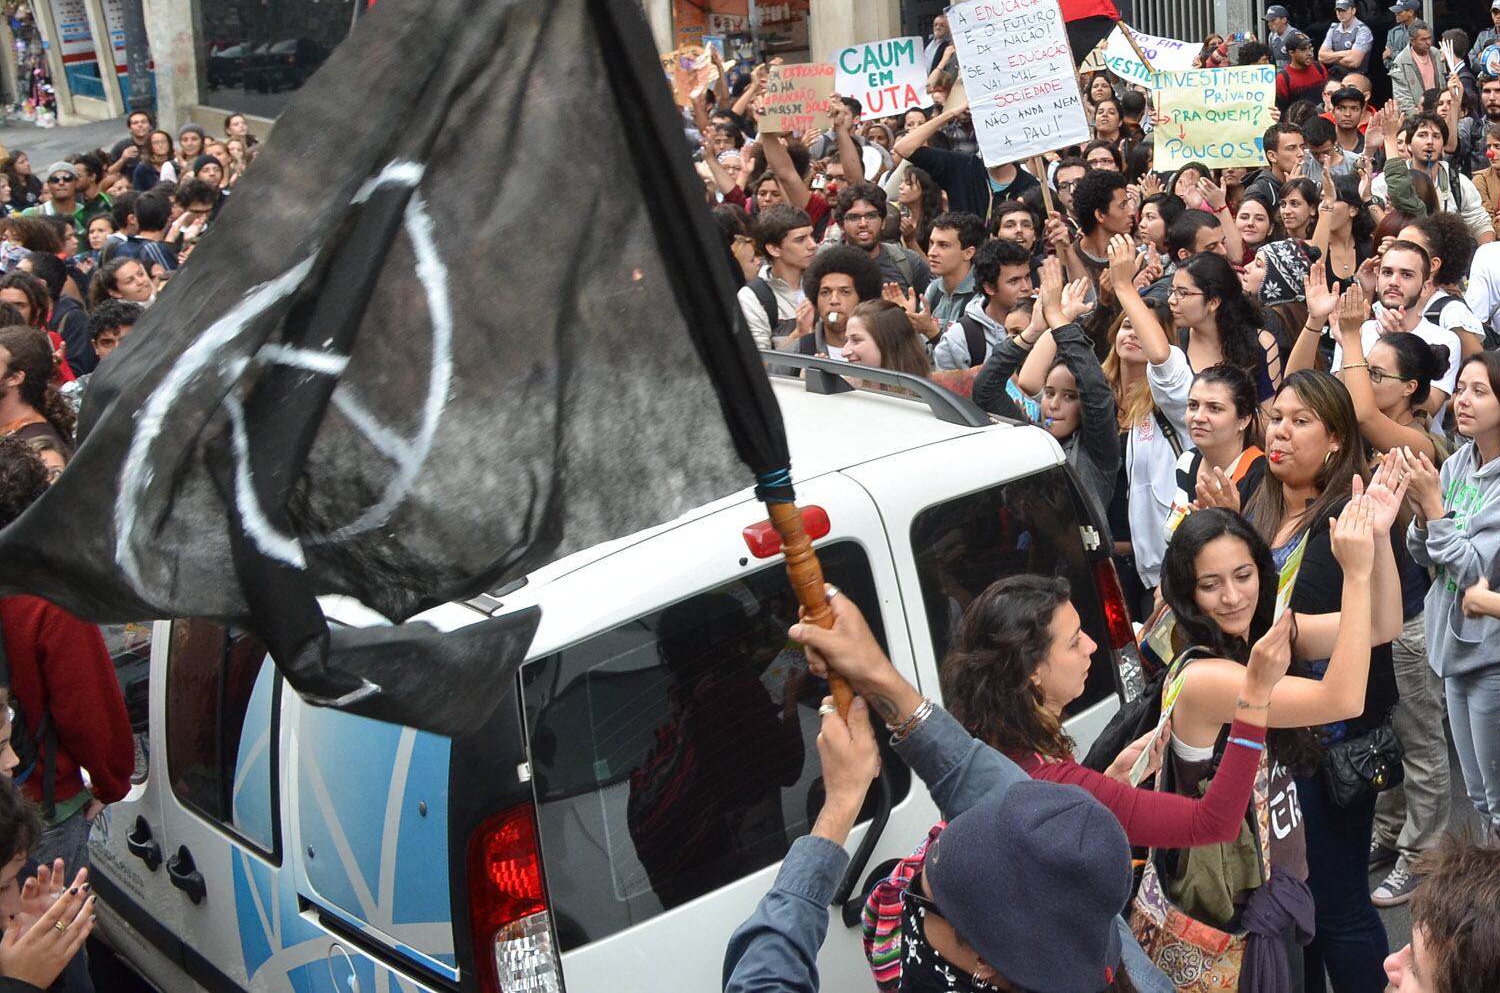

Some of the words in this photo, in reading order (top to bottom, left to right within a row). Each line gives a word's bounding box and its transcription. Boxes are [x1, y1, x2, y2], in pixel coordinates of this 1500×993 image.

[984, 23, 996, 37] O
[1003, 9, 1056, 32] FUTURO
[976, 44, 992, 55] DA
[1156, 39, 1183, 50] FIM
[839, 38, 915, 75] CAUM
[993, 62, 1001, 72] A
[1007, 41, 1068, 68] EDUCAÇÃO
[868, 70, 894, 88] EM
[983, 79, 1001, 91] VAI
[1012, 69, 1036, 85] MAL
[1152, 68, 1275, 90] INVESTIMENTO
[994, 78, 1063, 108] SOCIEDADE
[1204, 88, 1265, 104] PRIVADO
[985, 111, 1009, 128] NÃO
[1018, 104, 1044, 118] ANDA
[1053, 96, 1079, 109] NEM
[1173, 109, 1200, 124] PRA
[1205, 105, 1262, 126] QUEM?
[1003, 135, 1012, 147] A
[1165, 137, 1265, 161] POUCOS!
